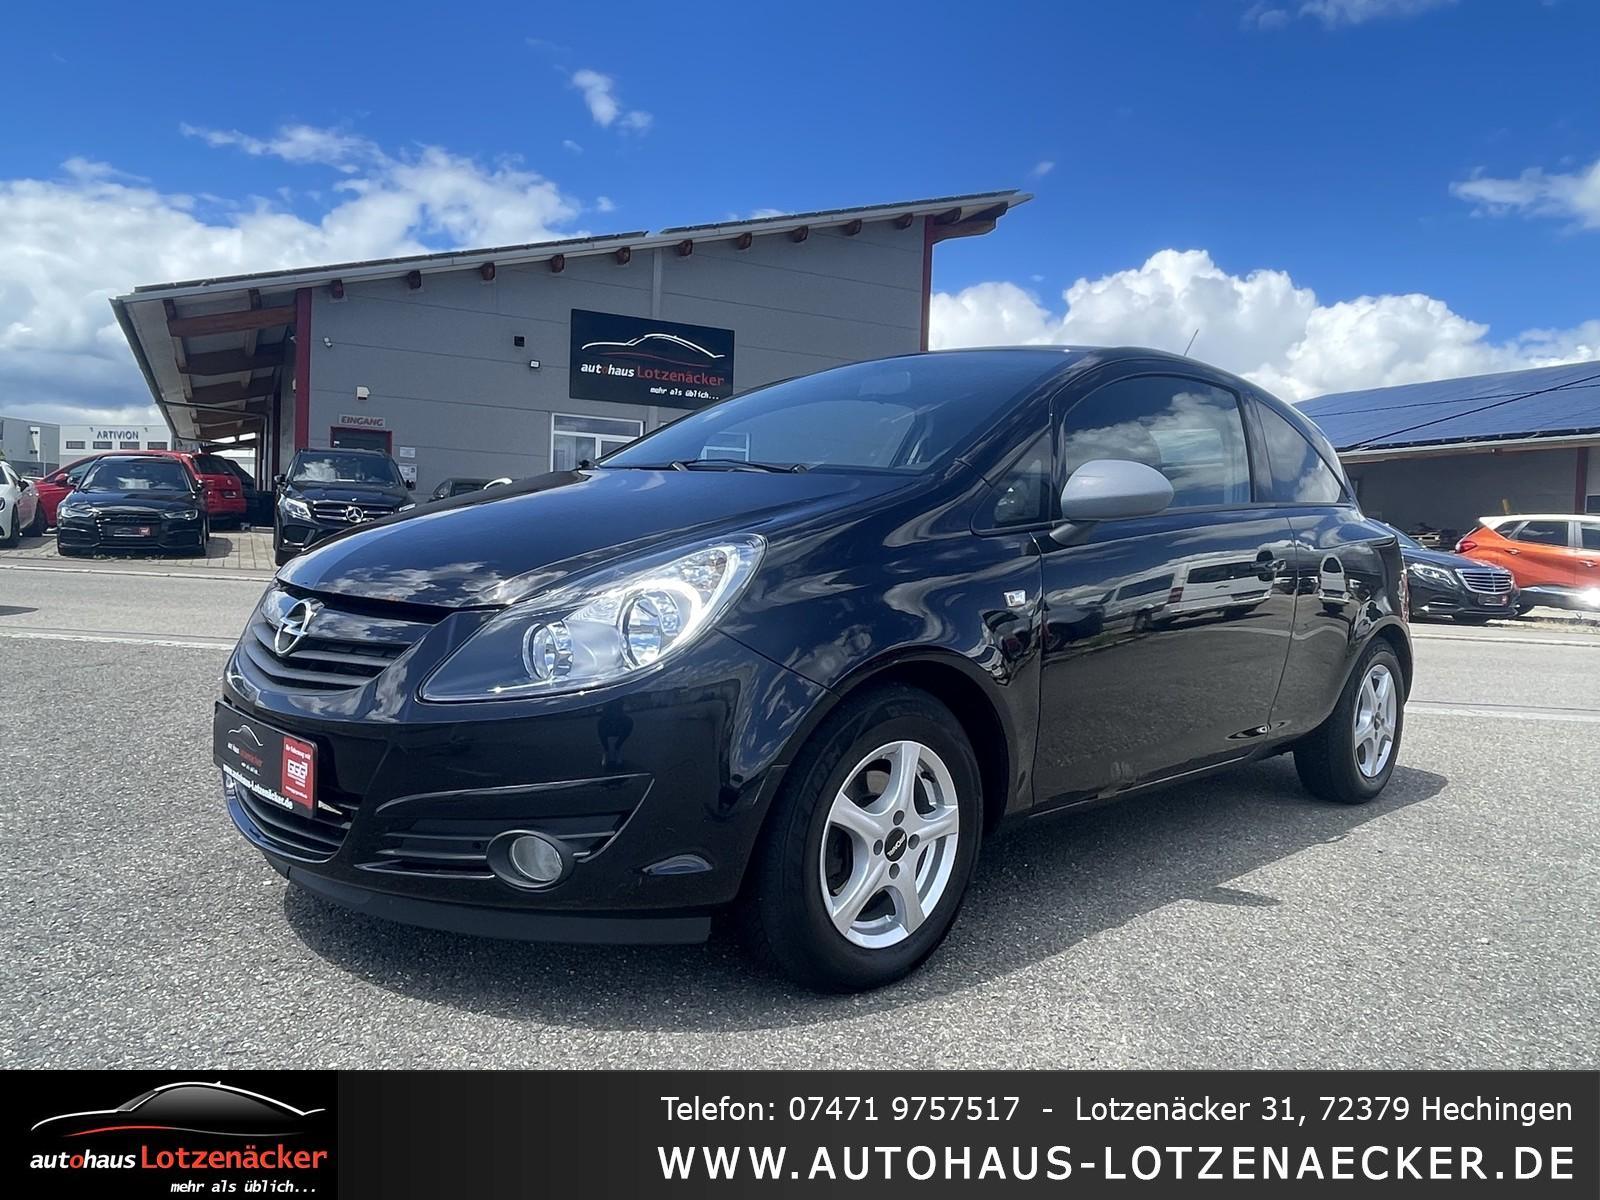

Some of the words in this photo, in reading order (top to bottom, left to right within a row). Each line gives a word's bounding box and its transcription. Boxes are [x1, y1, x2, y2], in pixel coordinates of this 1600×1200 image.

[581, 363, 635, 378] autohaus
[637, 366, 725, 386] Lotzenäcker
[670, 388, 683, 397] als
[342, 415, 384, 427] EINGANG
[97, 430, 139, 440] ARTIVION
